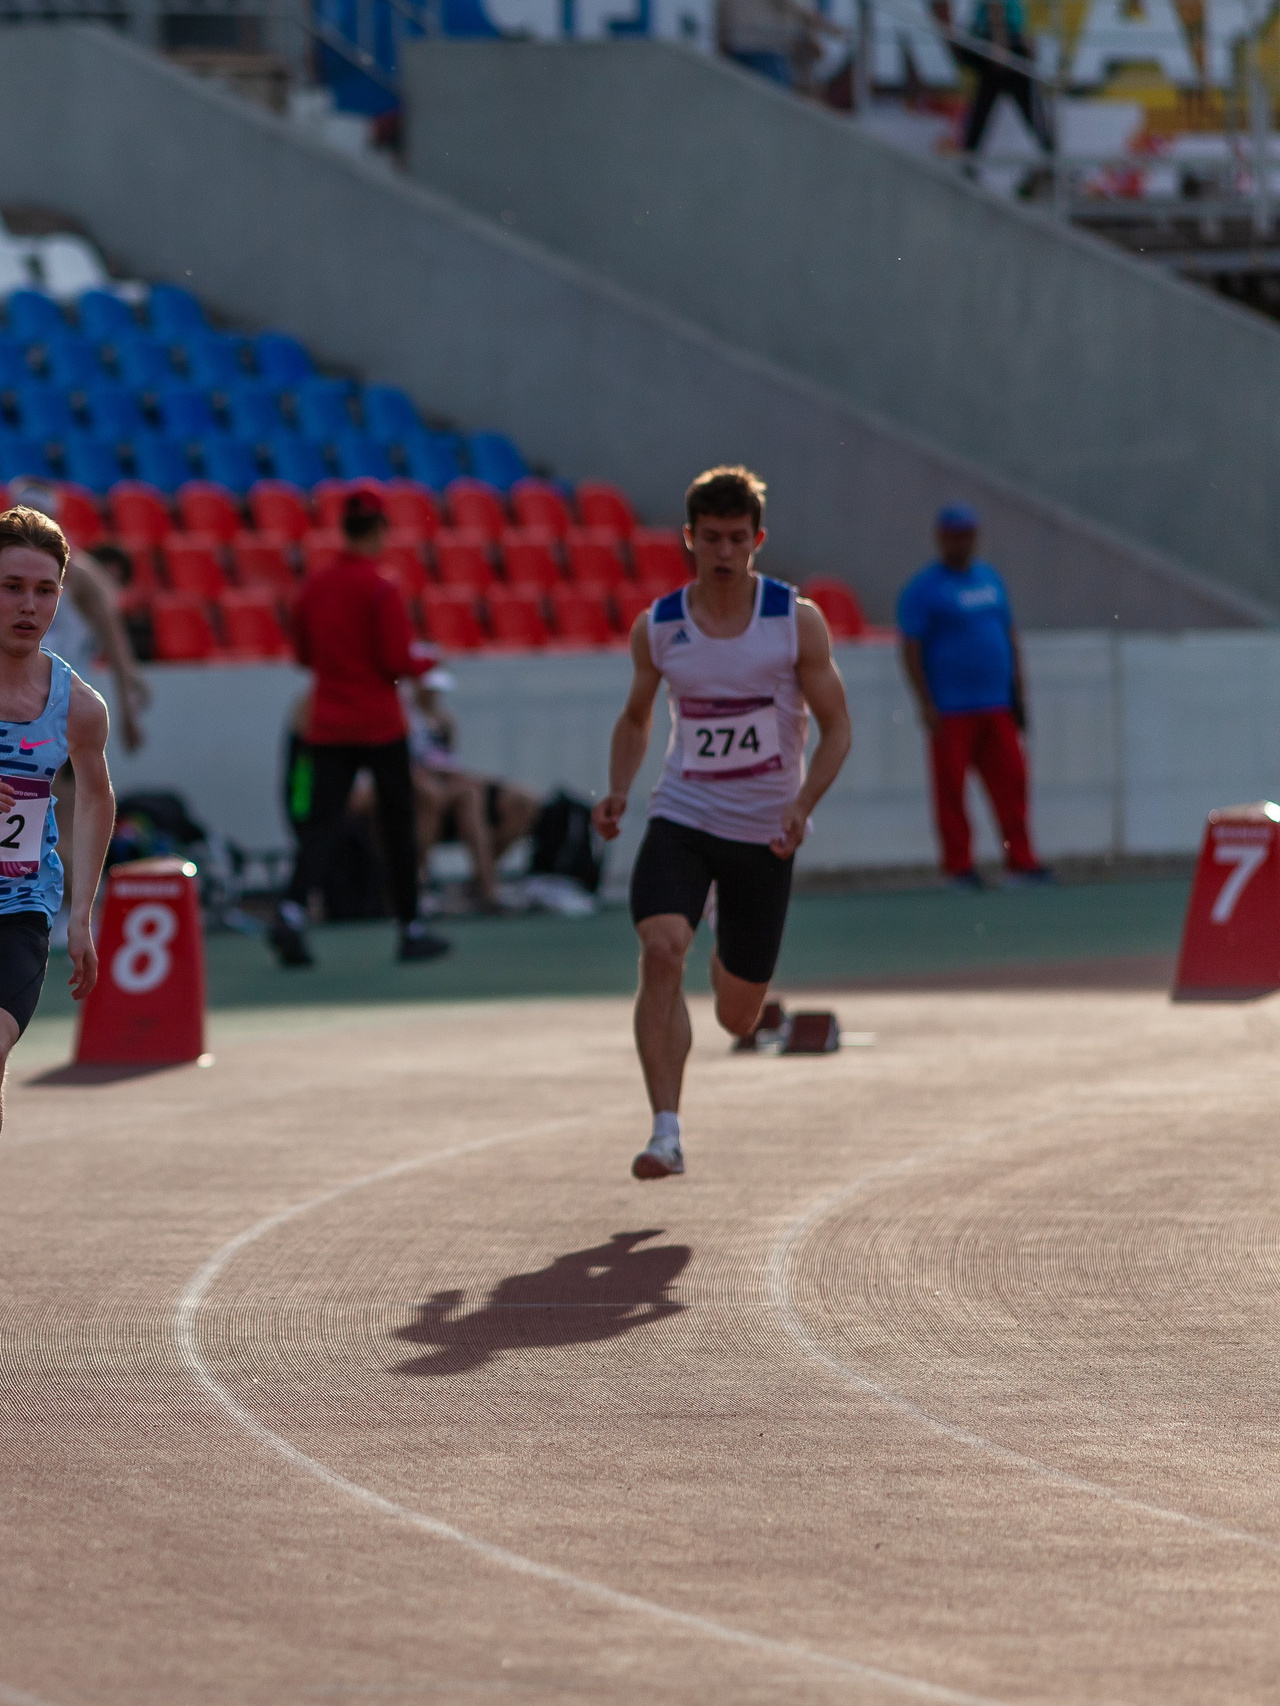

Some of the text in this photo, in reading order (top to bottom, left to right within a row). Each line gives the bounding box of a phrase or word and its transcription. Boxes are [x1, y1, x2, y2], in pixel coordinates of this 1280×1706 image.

[695, 725, 760, 757] 274
[1210, 845, 1270, 926] 7
[110, 902, 180, 995] 8
